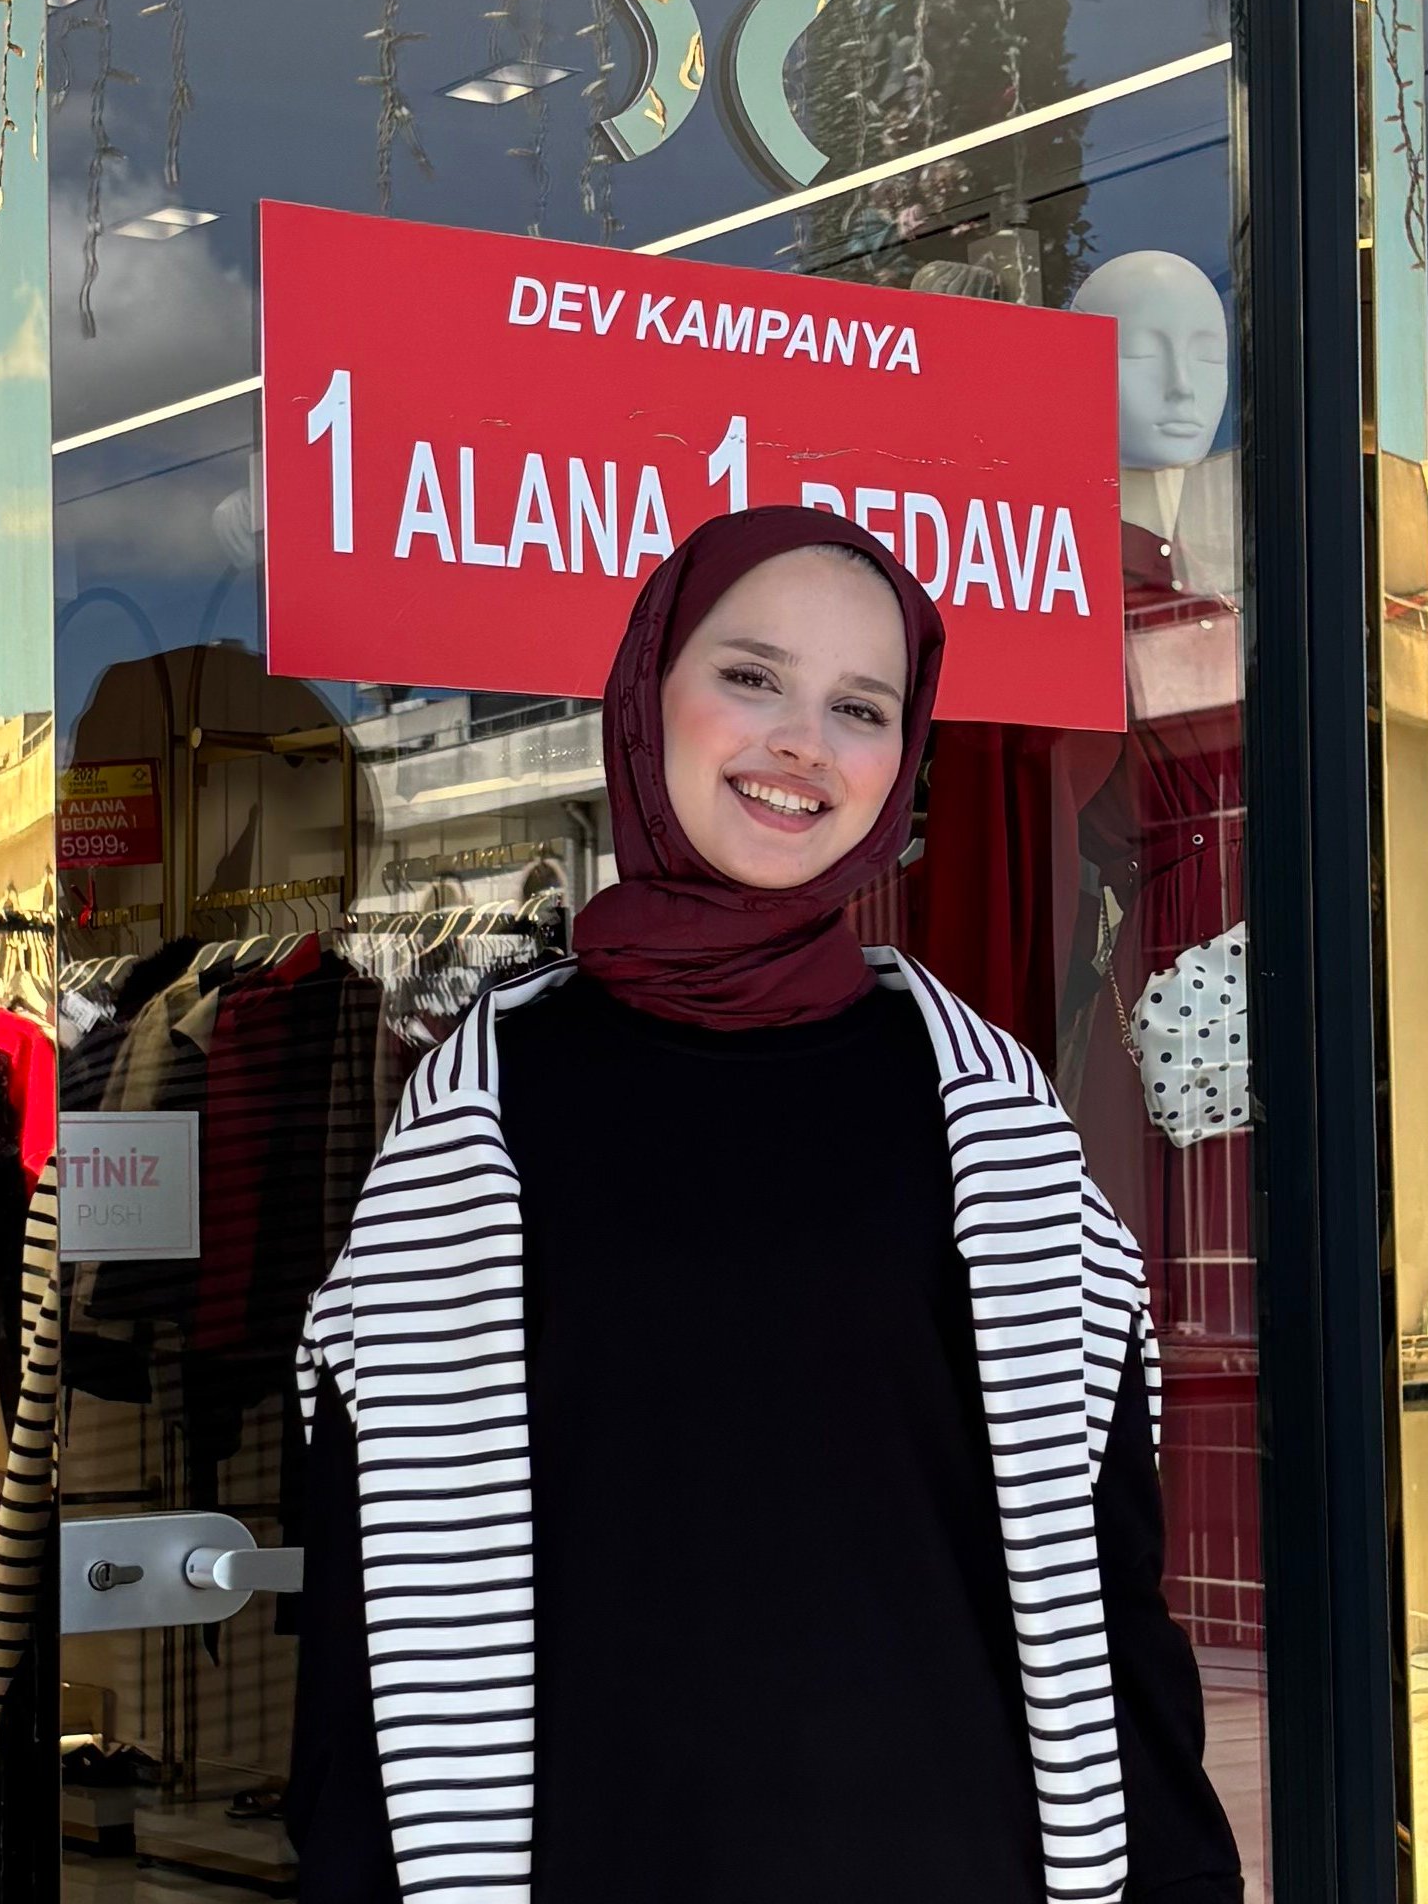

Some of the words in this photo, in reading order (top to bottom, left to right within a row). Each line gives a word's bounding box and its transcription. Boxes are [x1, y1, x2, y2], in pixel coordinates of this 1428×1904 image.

[508, 276, 626, 335] DEV
[635, 293, 920, 374] KAMPANYA
[307, 369, 354, 554] 1
[394, 440, 675, 578] ALANA
[69, 799, 127, 816] ALANA
[61, 815, 129, 832] BEDAVA
[77, 1203, 143, 1227] PUSH
